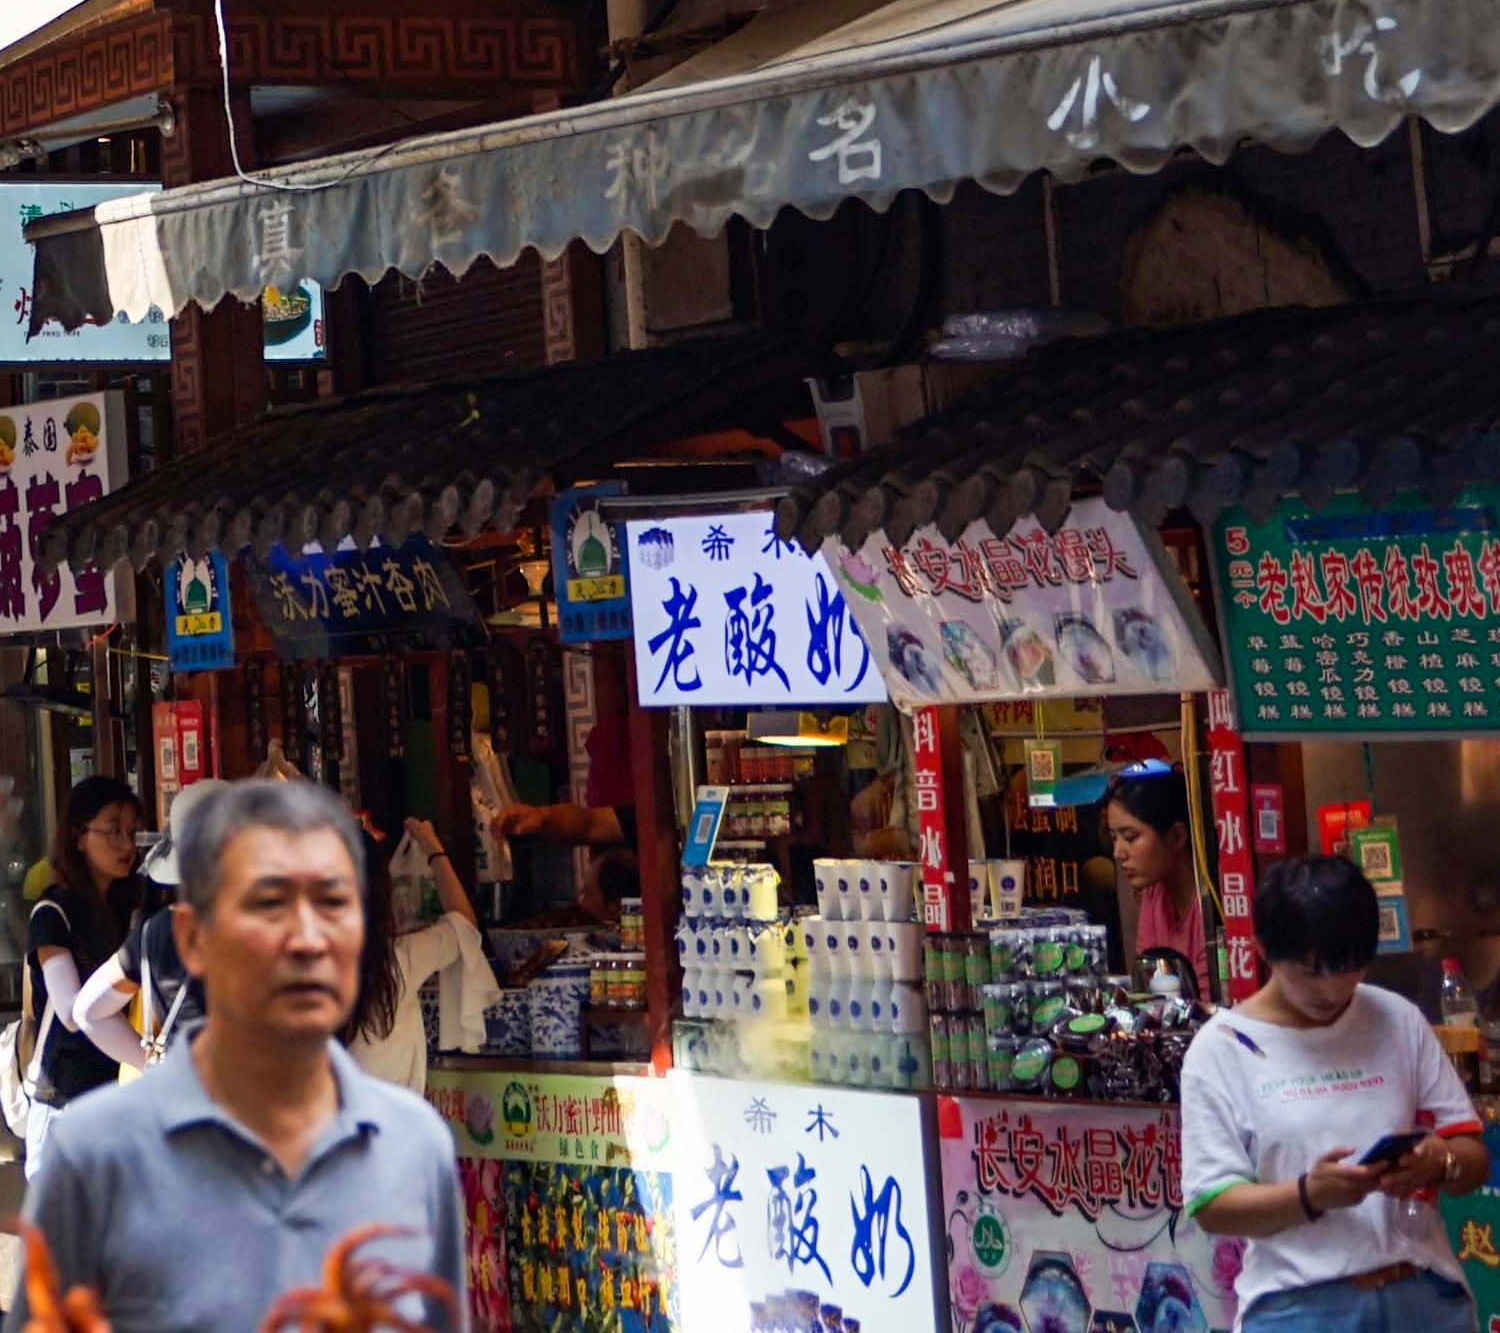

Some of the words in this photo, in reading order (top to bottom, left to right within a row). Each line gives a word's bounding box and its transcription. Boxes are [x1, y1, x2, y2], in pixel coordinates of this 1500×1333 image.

[21, 416, 57, 456] 泰国
[648, 570, 871, 694] 老酸奶
[743, 1095, 841, 1142] 希木
[690, 1143, 917, 1299] 老酸奶
